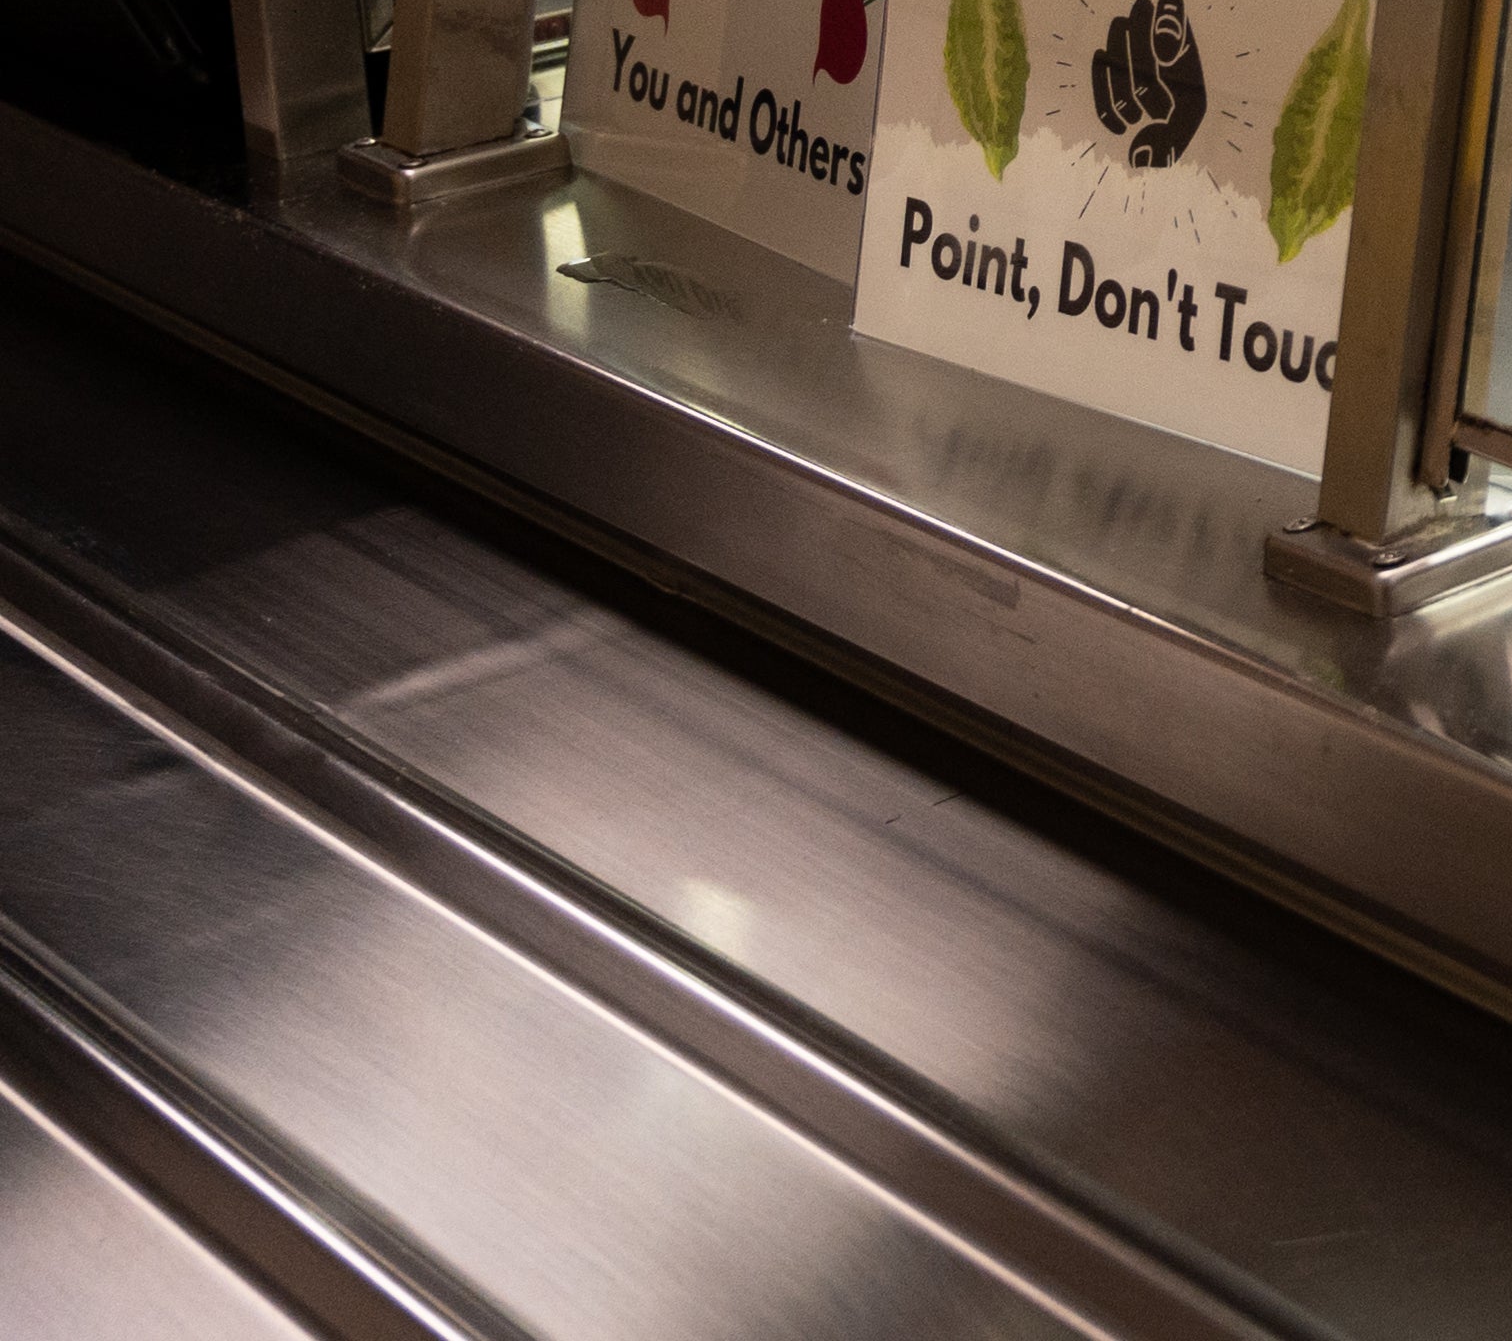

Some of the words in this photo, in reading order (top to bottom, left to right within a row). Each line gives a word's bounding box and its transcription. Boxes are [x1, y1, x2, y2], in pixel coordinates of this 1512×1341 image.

[612, 27, 670, 112] You
[676, 75, 745, 143] and
[749, 87, 866, 196] Others
[900, 196, 1041, 320] Point,
[1057, 239, 1199, 352] Don't
